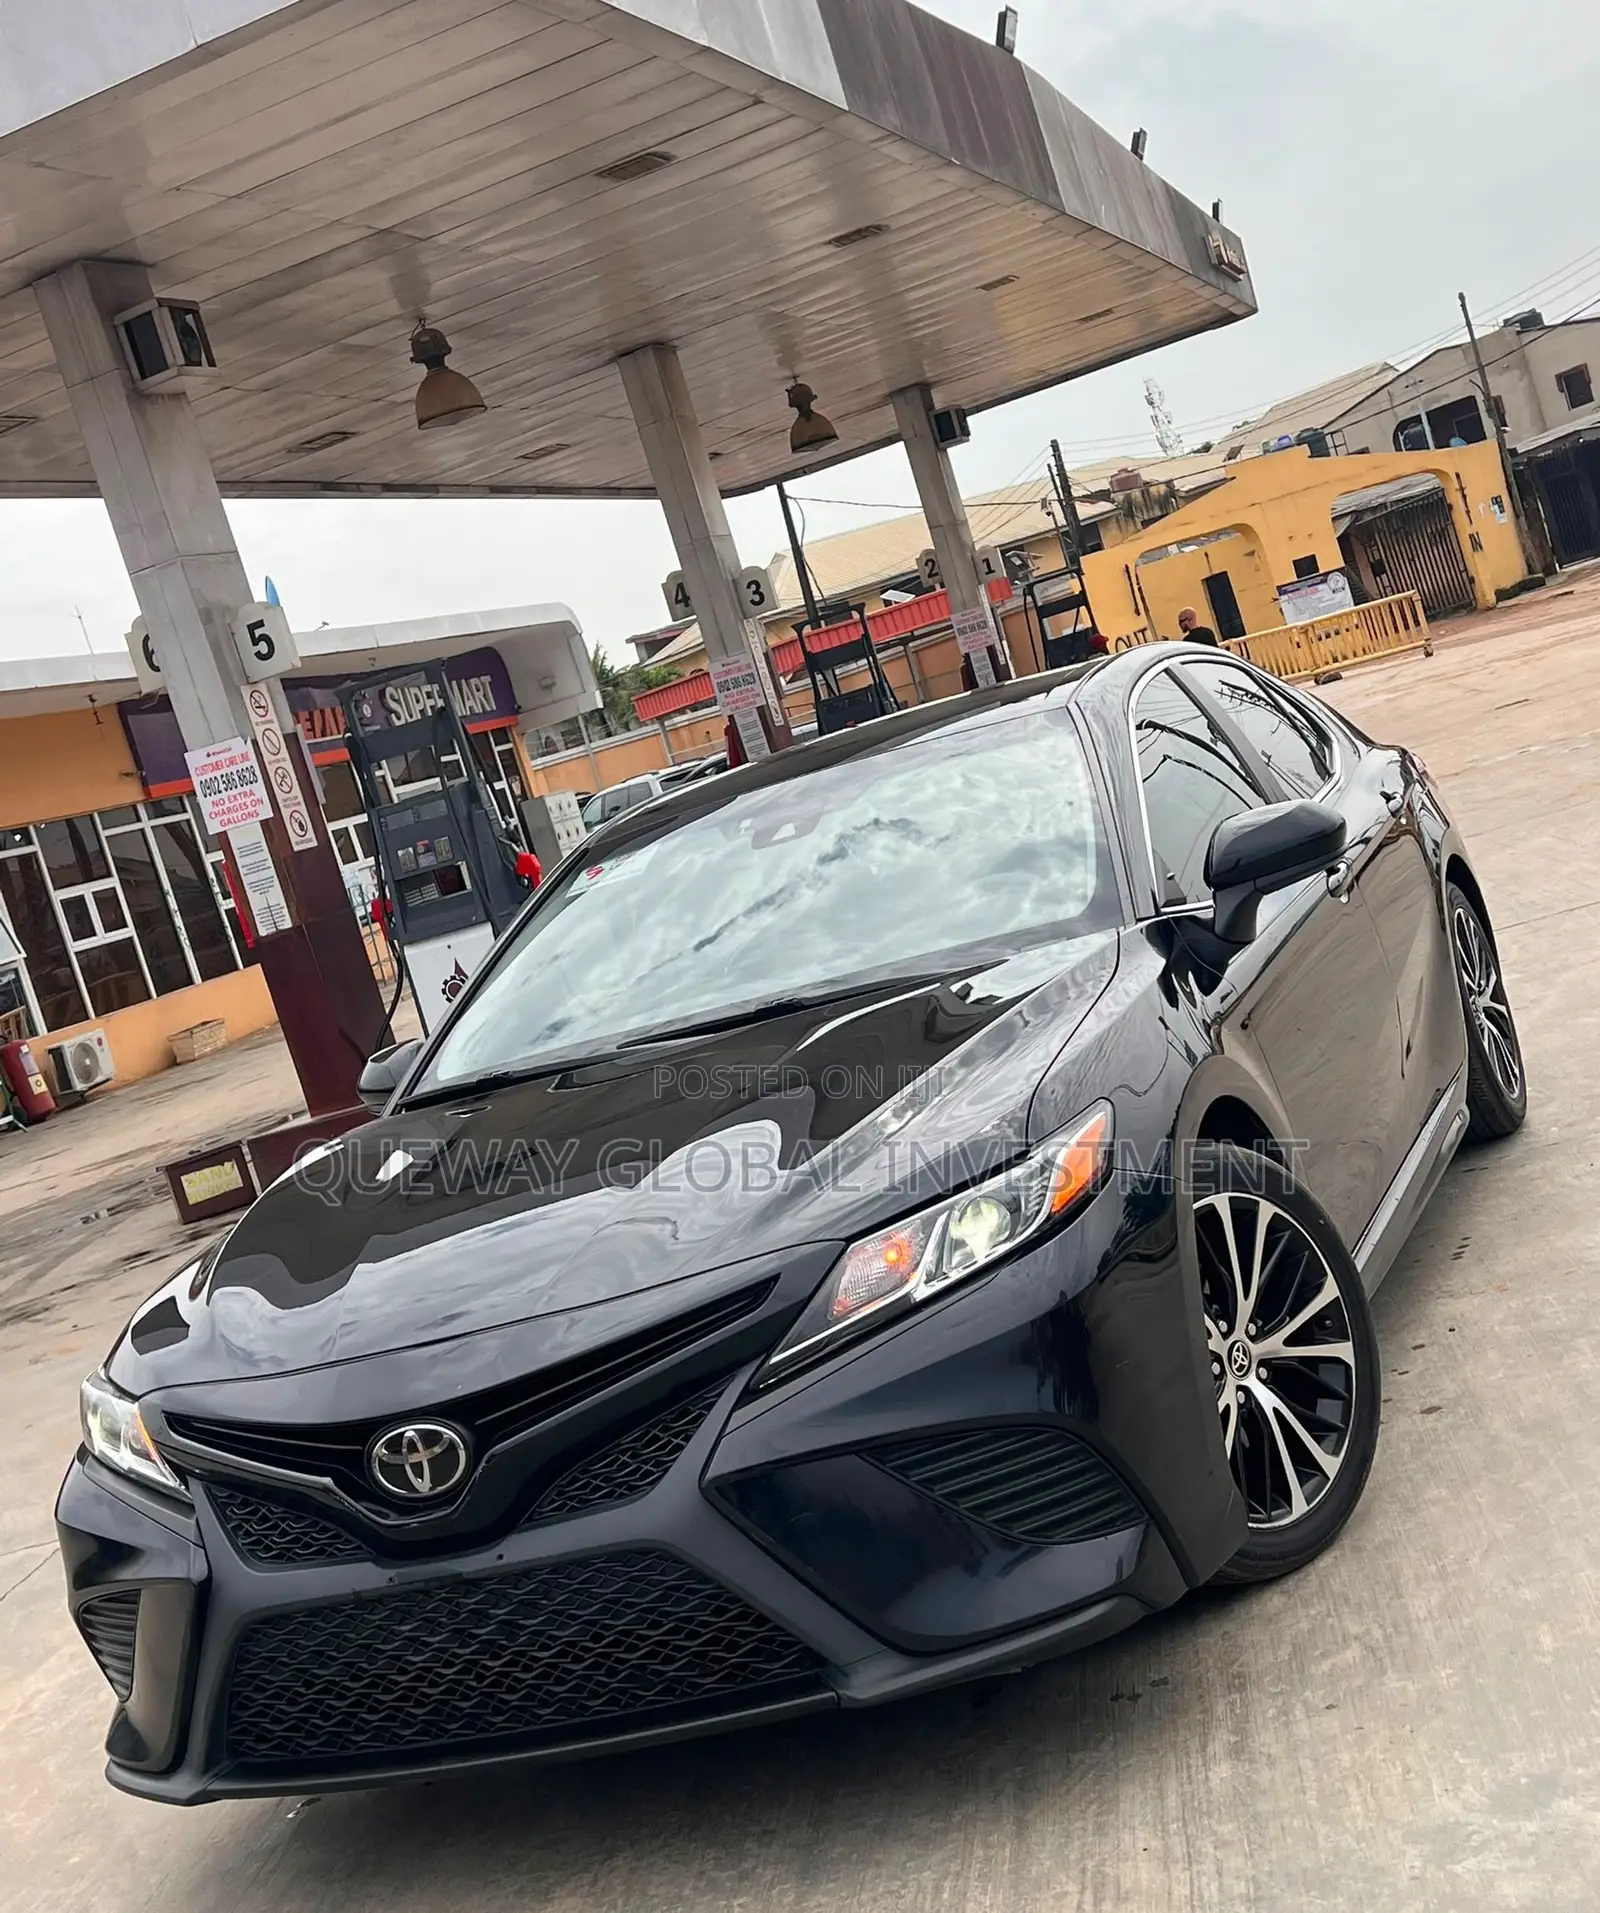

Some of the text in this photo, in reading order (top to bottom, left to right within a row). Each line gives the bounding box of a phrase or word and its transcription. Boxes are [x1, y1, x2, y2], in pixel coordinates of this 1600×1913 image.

[1468, 531, 1483, 552] IN
[924, 557, 939, 579] 2
[982, 557, 995, 575] 1
[674, 582, 691, 608] 4
[746, 579, 766, 607] 3
[246, 618, 276, 662] 5
[1115, 626, 1147, 653] OUT
[195, 760, 225, 778] CUSTOMER
[200, 765, 258, 798] 0902 586 8628
[209, 801, 249, 820] CHARGES
[250, 797, 264, 808] ON
[211, 789, 256, 808] NO EXTRA
[220, 809, 260, 827] GALLONS
